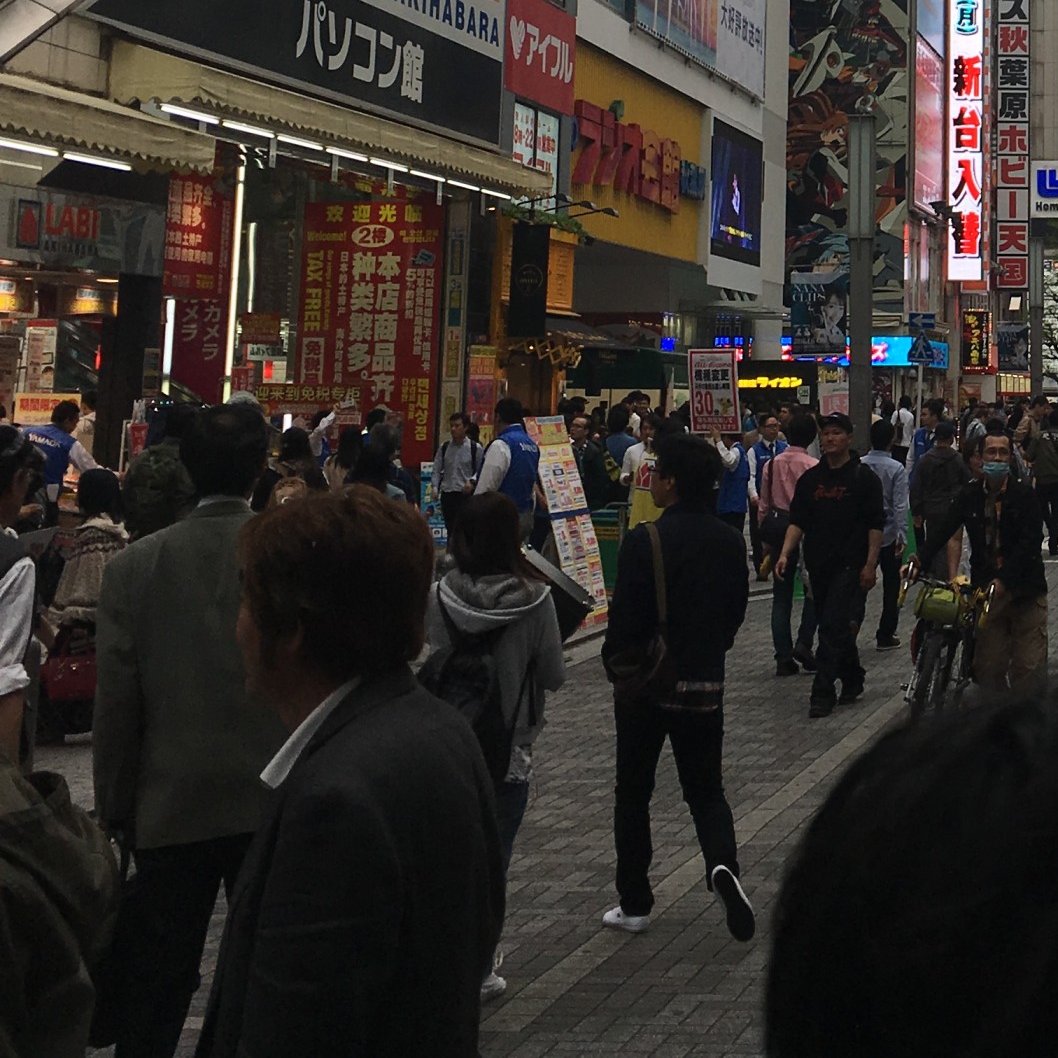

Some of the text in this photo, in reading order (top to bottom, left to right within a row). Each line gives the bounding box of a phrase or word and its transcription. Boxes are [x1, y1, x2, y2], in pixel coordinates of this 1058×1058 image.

[296, 0, 424, 104] パソコン館
[524, 22, 574, 84] アイフル
[951, 55, 982, 259] 新台入替
[45, 203, 98, 240] LABI
[303, 248, 325, 332] TAX FREE
[414, 378, 430, 442] 면세상점
[695, 391, 714, 415] 30
